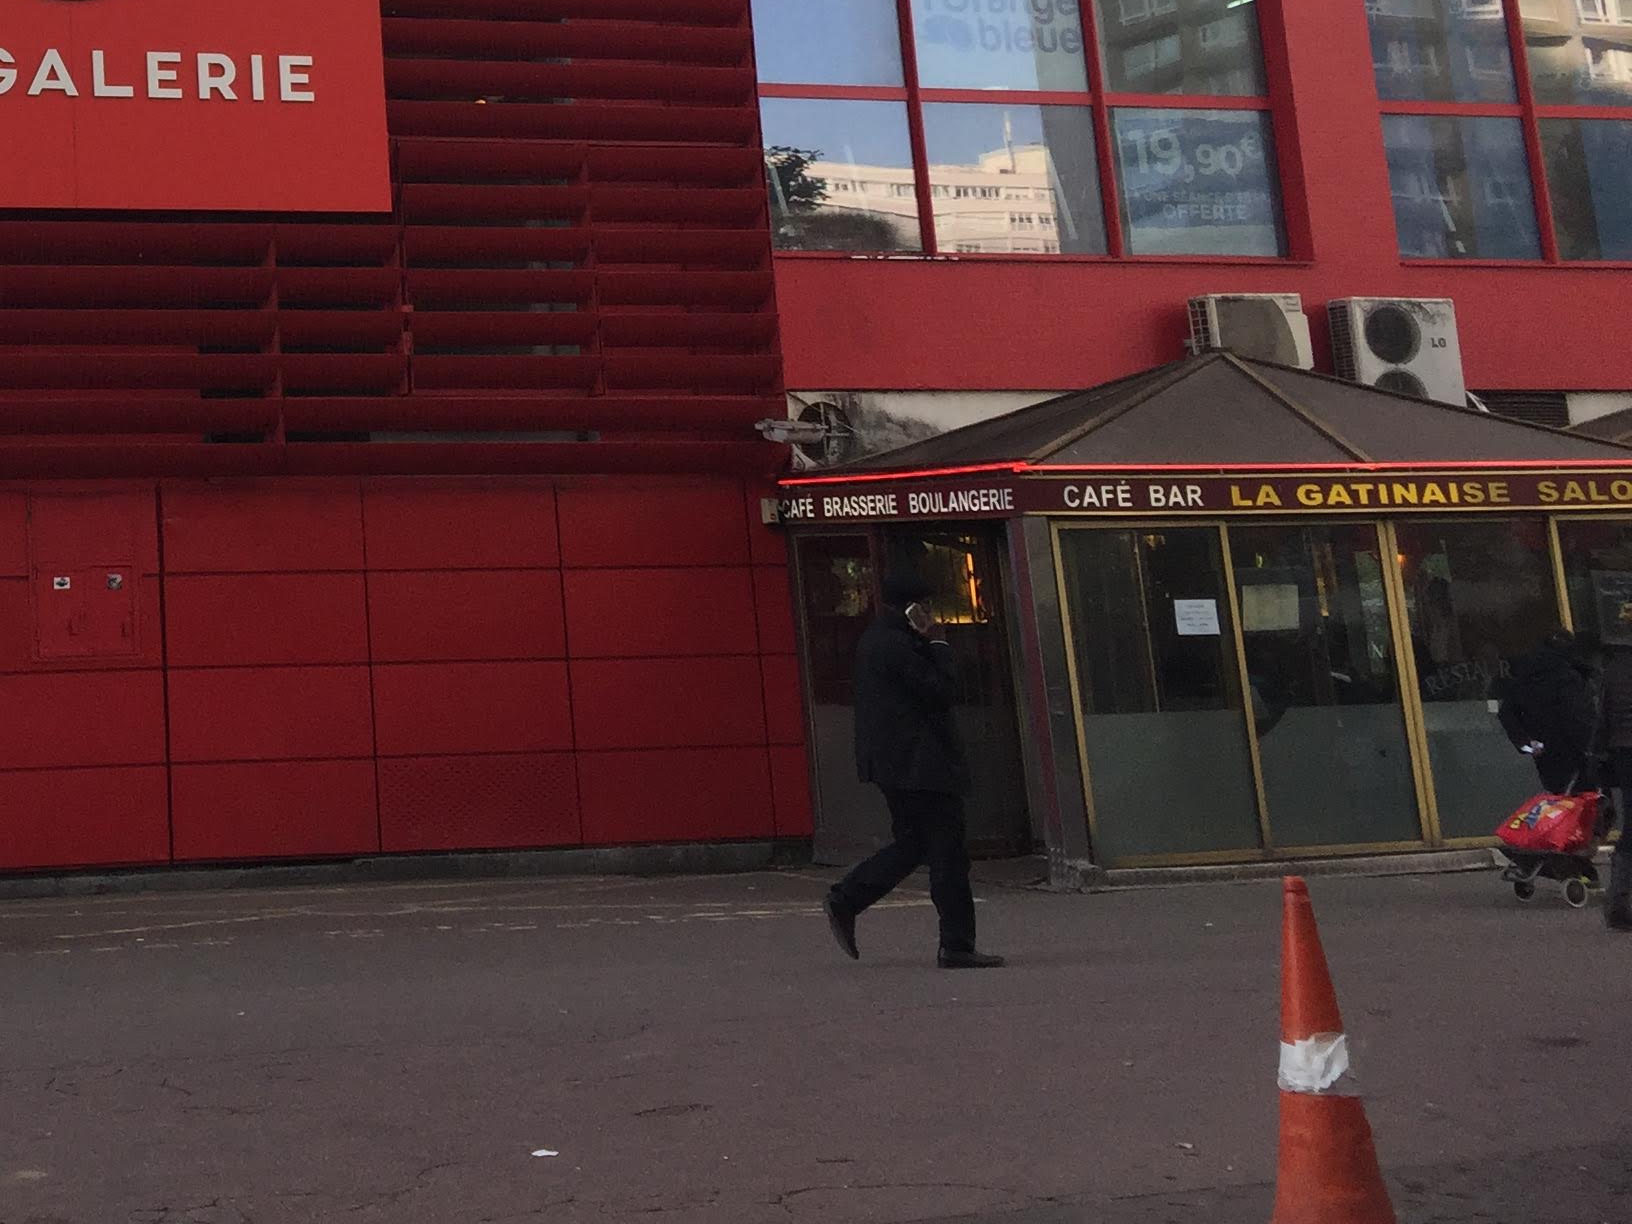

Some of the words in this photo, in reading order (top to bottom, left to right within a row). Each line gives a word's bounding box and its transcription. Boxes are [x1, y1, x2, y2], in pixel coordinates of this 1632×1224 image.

[977, 17, 1082, 54] bleue
[1162, 203, 1247, 220] OFFERTE
[1430, 337, 1447, 348] LG
[782, 493, 815, 519] CAFÉ
[823, 493, 899, 517] BRASSERIE
[908, 487, 1015, 514] BOULANGERIE
[1063, 479, 1134, 509] CAFÉ
[1148, 484, 1205, 507] BAR
[1230, 483, 1282, 507] LA
[1296, 481, 1512, 506] GATINAISE
[1536, 479, 1632, 503] SALO
